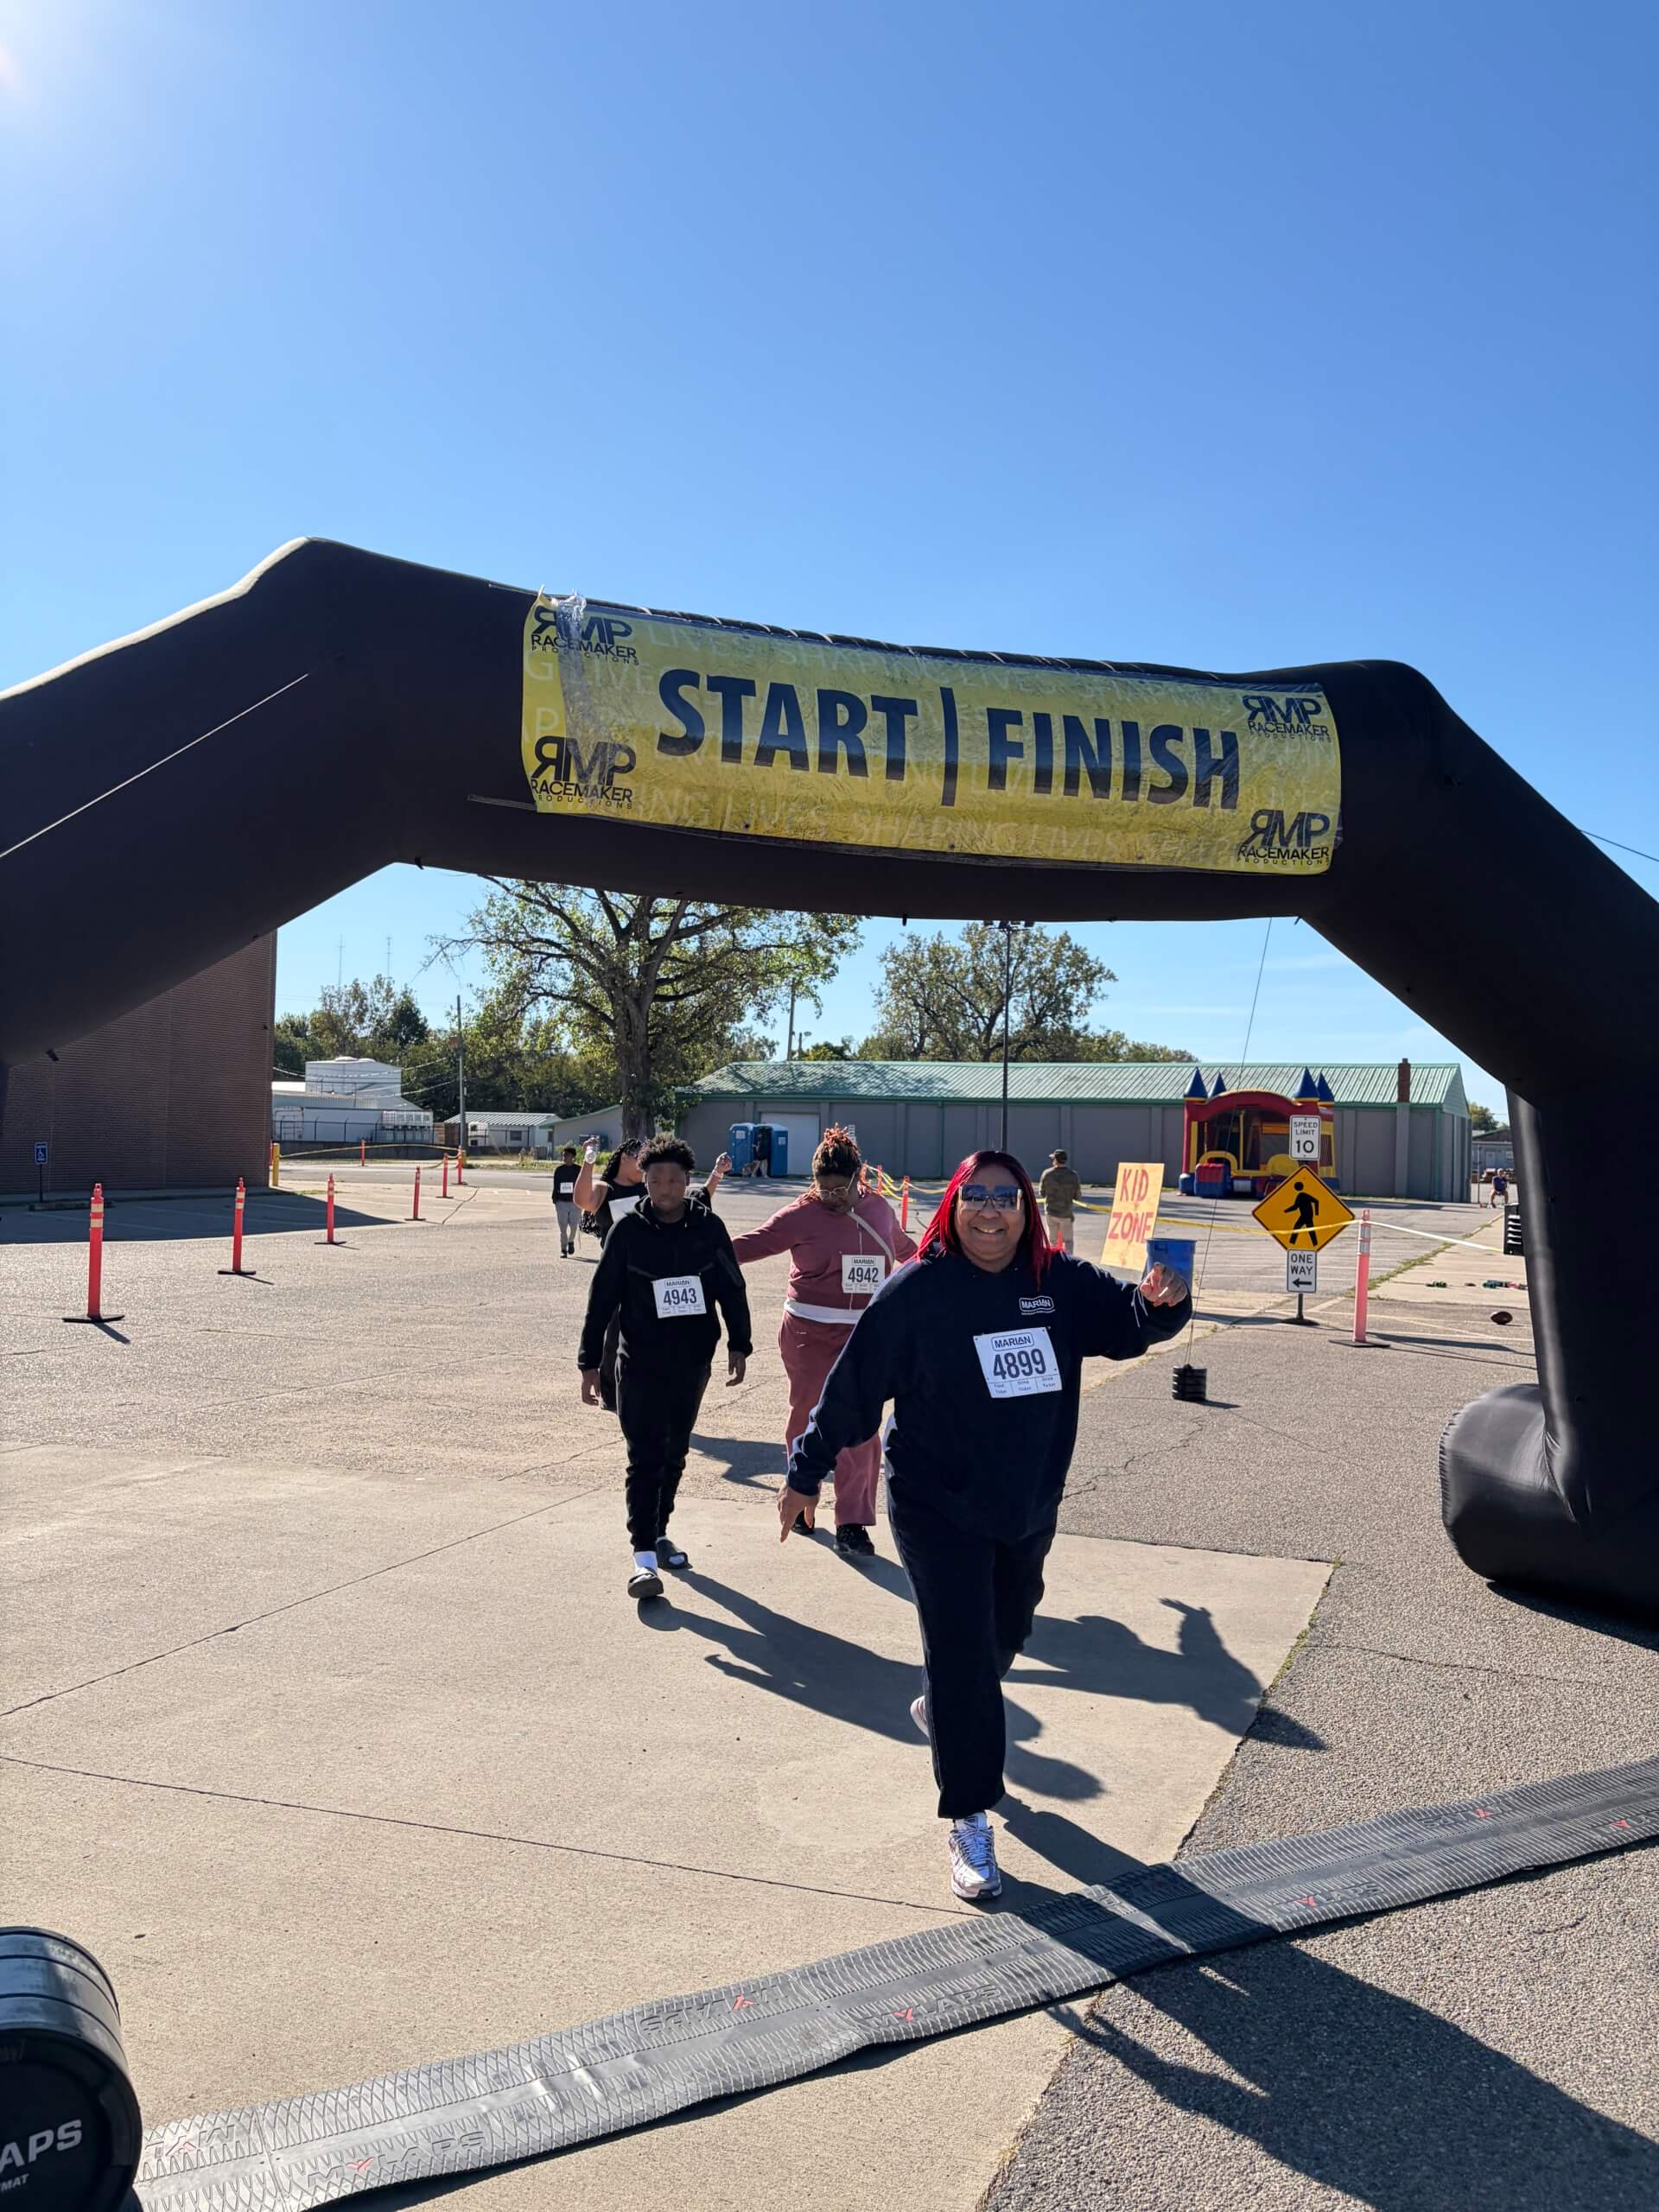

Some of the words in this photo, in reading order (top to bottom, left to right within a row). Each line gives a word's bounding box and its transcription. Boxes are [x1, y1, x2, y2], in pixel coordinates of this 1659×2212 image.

[531, 634, 638, 659] RACEMAKER
[531, 645, 639, 666] PRODCTIONS
[1247, 720, 1330, 737] RACEMAKER
[657, 668, 918, 781] START
[986, 707, 1240, 810] FINISH
[531, 779, 633, 803] RACEMAKER
[537, 795, 633, 810] RODUCTIONS
[1236, 844, 1330, 861] RACEMAKER
[1296, 1140, 1314, 1154] 10
[1120, 1168, 1150, 1203] KID
[1107, 1211, 1154, 1244] ZONE
[1291, 1253, 1313, 1264] ONE
[848, 1267, 879, 1283] 4942
[1290, 1265, 1313, 1275] WAY
[663, 1287, 697, 1306] 4943
[1021, 1299, 1052, 1309] MARIAN
[994, 1335, 1032, 1349] MARIAN
[993, 1348, 1046, 1380] 4899
[863, 1983, 1001, 2027] MYLAPS
[308, 2131, 486, 2188] MYLAPS
